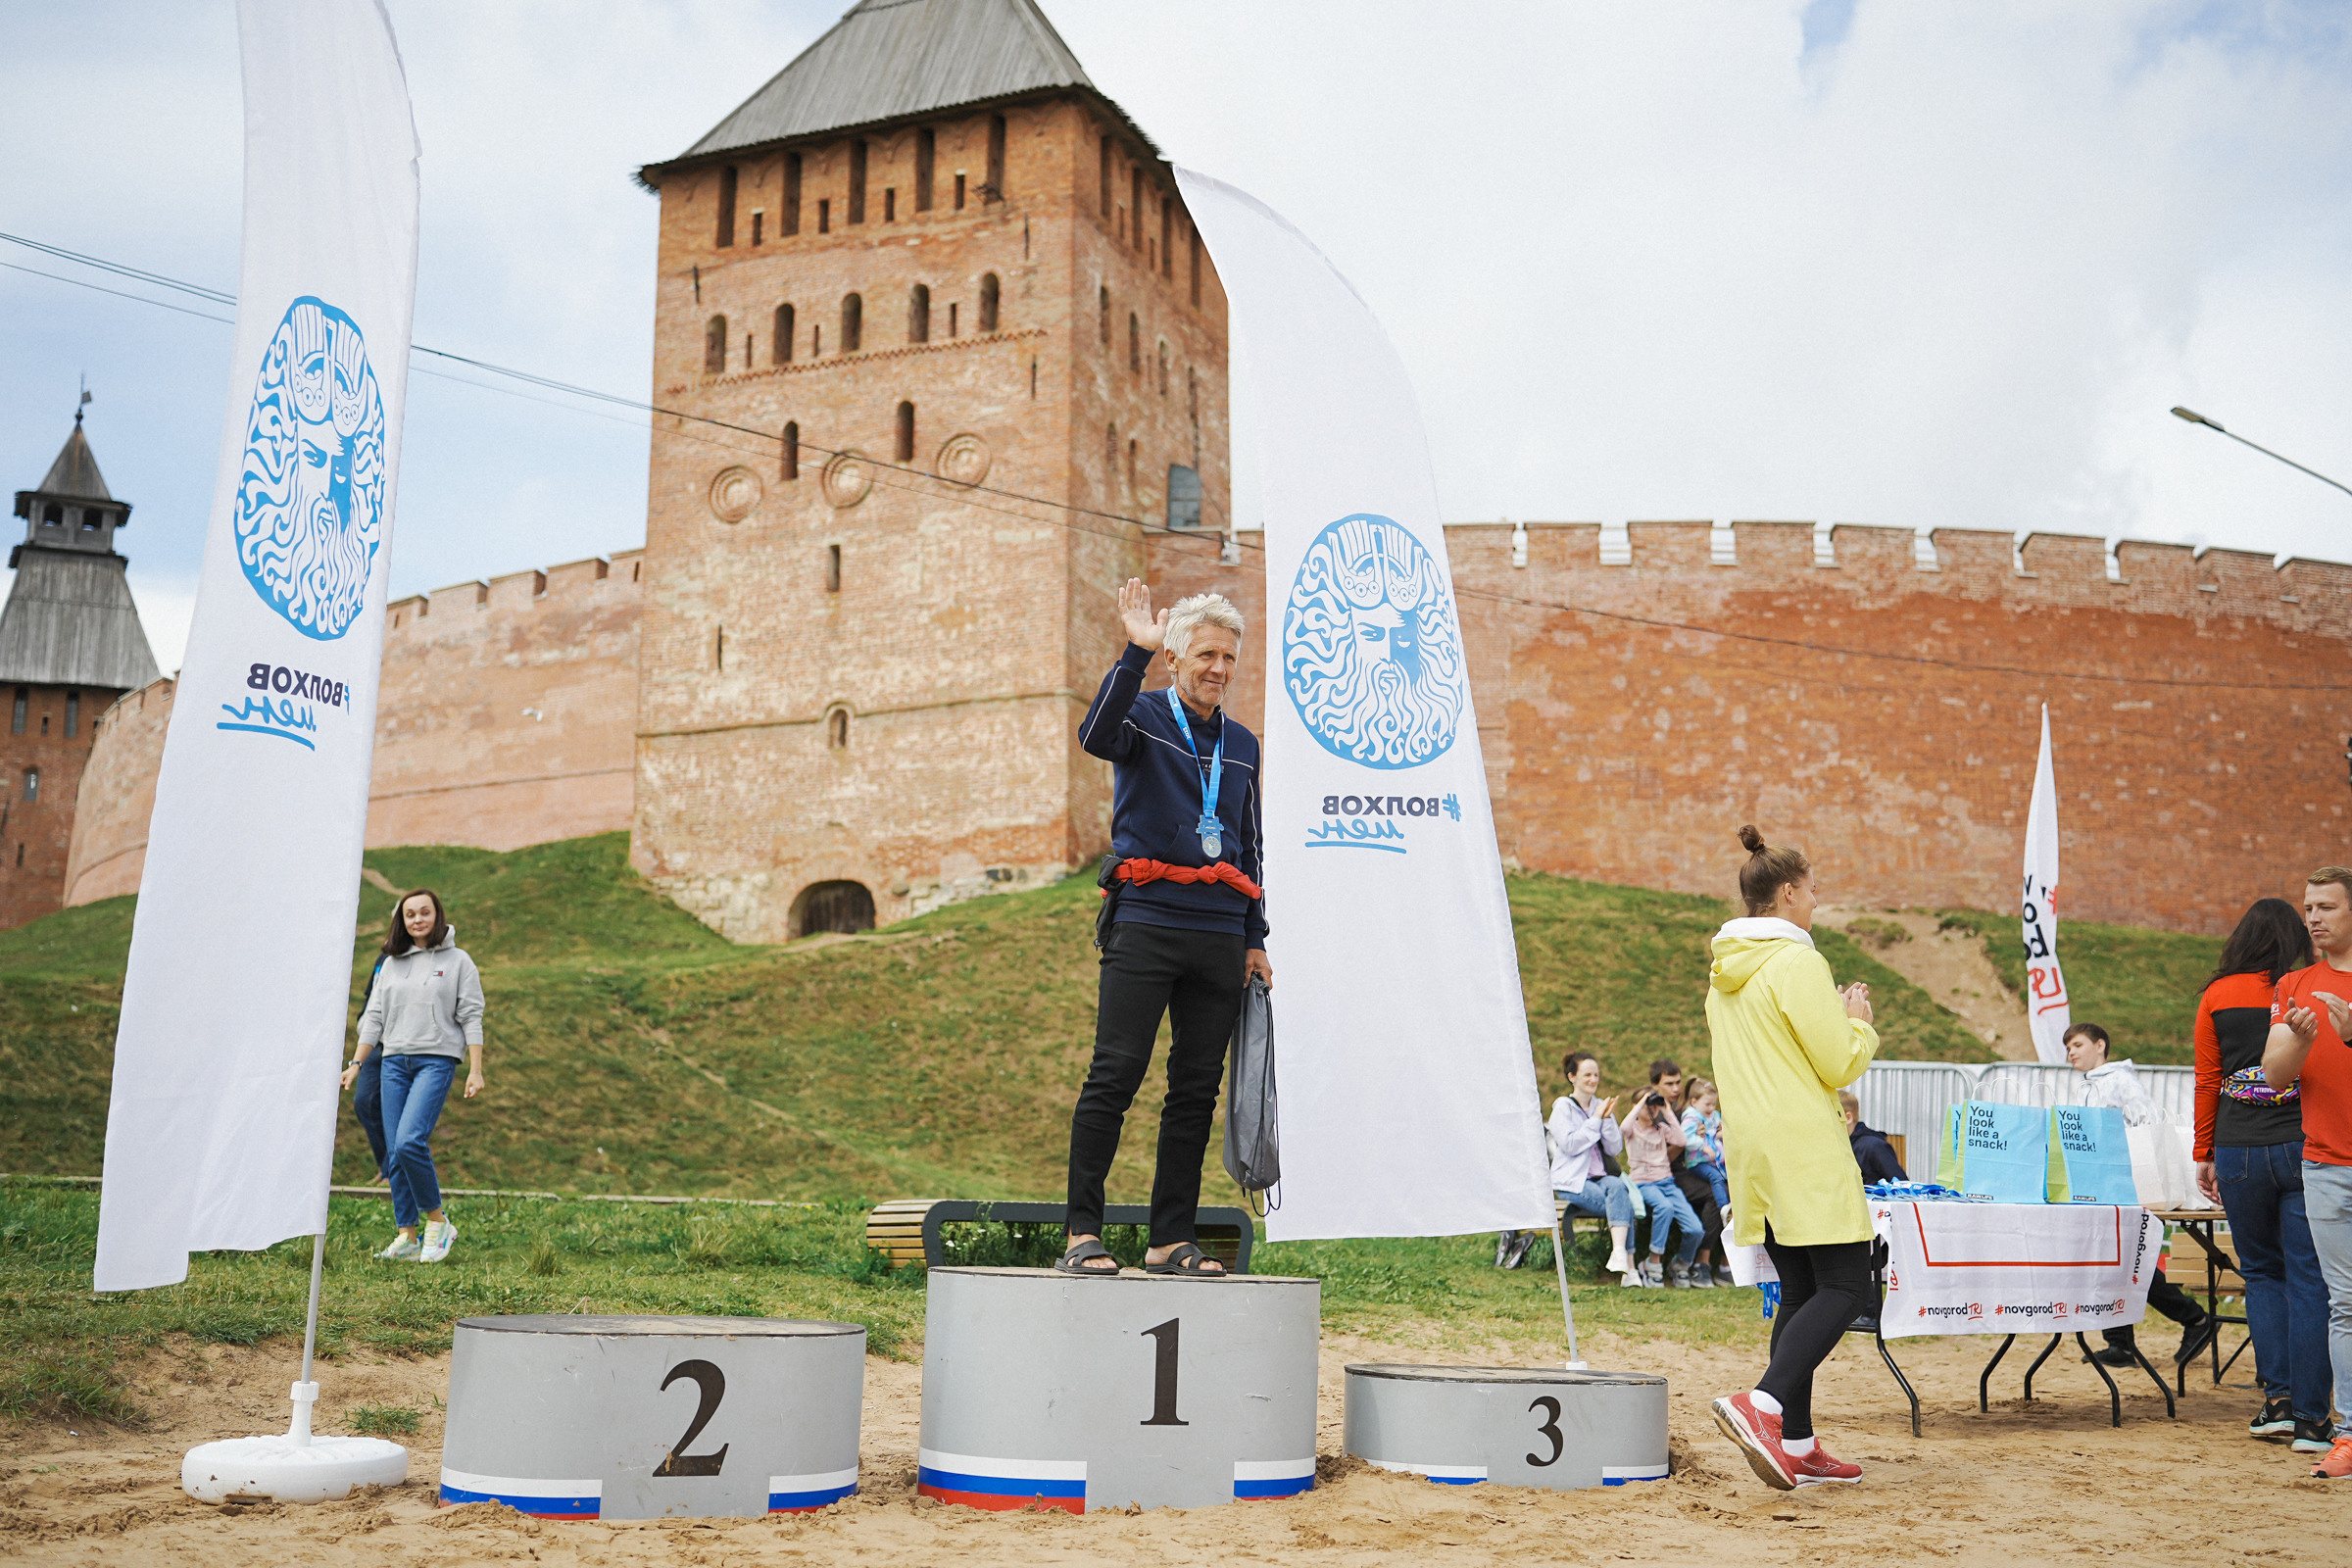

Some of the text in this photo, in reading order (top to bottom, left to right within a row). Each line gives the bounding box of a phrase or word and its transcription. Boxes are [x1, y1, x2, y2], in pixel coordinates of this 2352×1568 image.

[1970, 1105, 1993, 1118] You
[2058, 1110, 2081, 1121] You
[1969, 1116, 1994, 1128] look
[2060, 1121, 2083, 1131] look
[1969, 1126, 1999, 1140] like a
[2062, 1130, 2081, 1141] like
[1968, 1138, 2008, 1151] snack!
[2063, 1142, 2096, 1152] snack!
[1141, 1317, 1189, 1425] 1
[653, 1359, 729, 1477] 2
[1526, 1396, 1563, 1466] 3
